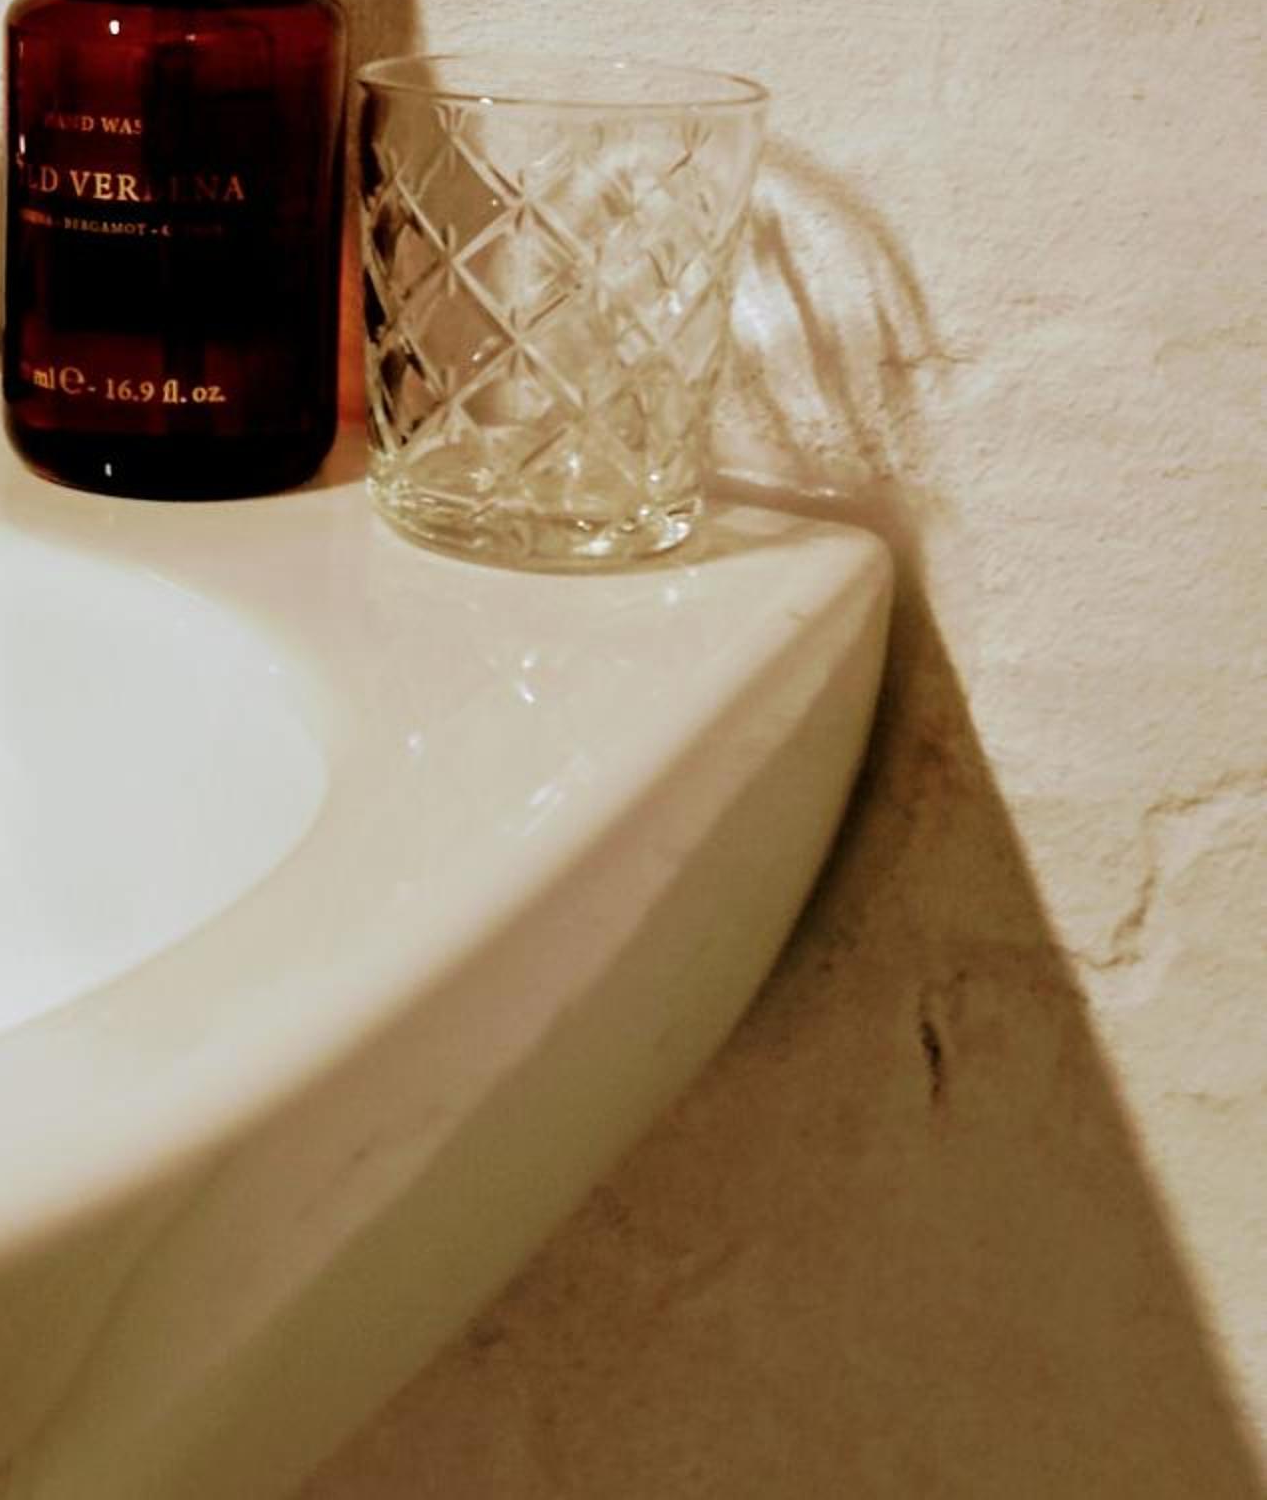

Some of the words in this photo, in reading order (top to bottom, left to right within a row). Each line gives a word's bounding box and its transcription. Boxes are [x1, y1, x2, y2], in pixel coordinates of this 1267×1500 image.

[101, 116, 143, 136] WAS
[69, 169, 245, 202] VERNA
[63, 216, 147, 237] BERGAMOT
[106, 378, 155, 401] 16.9
